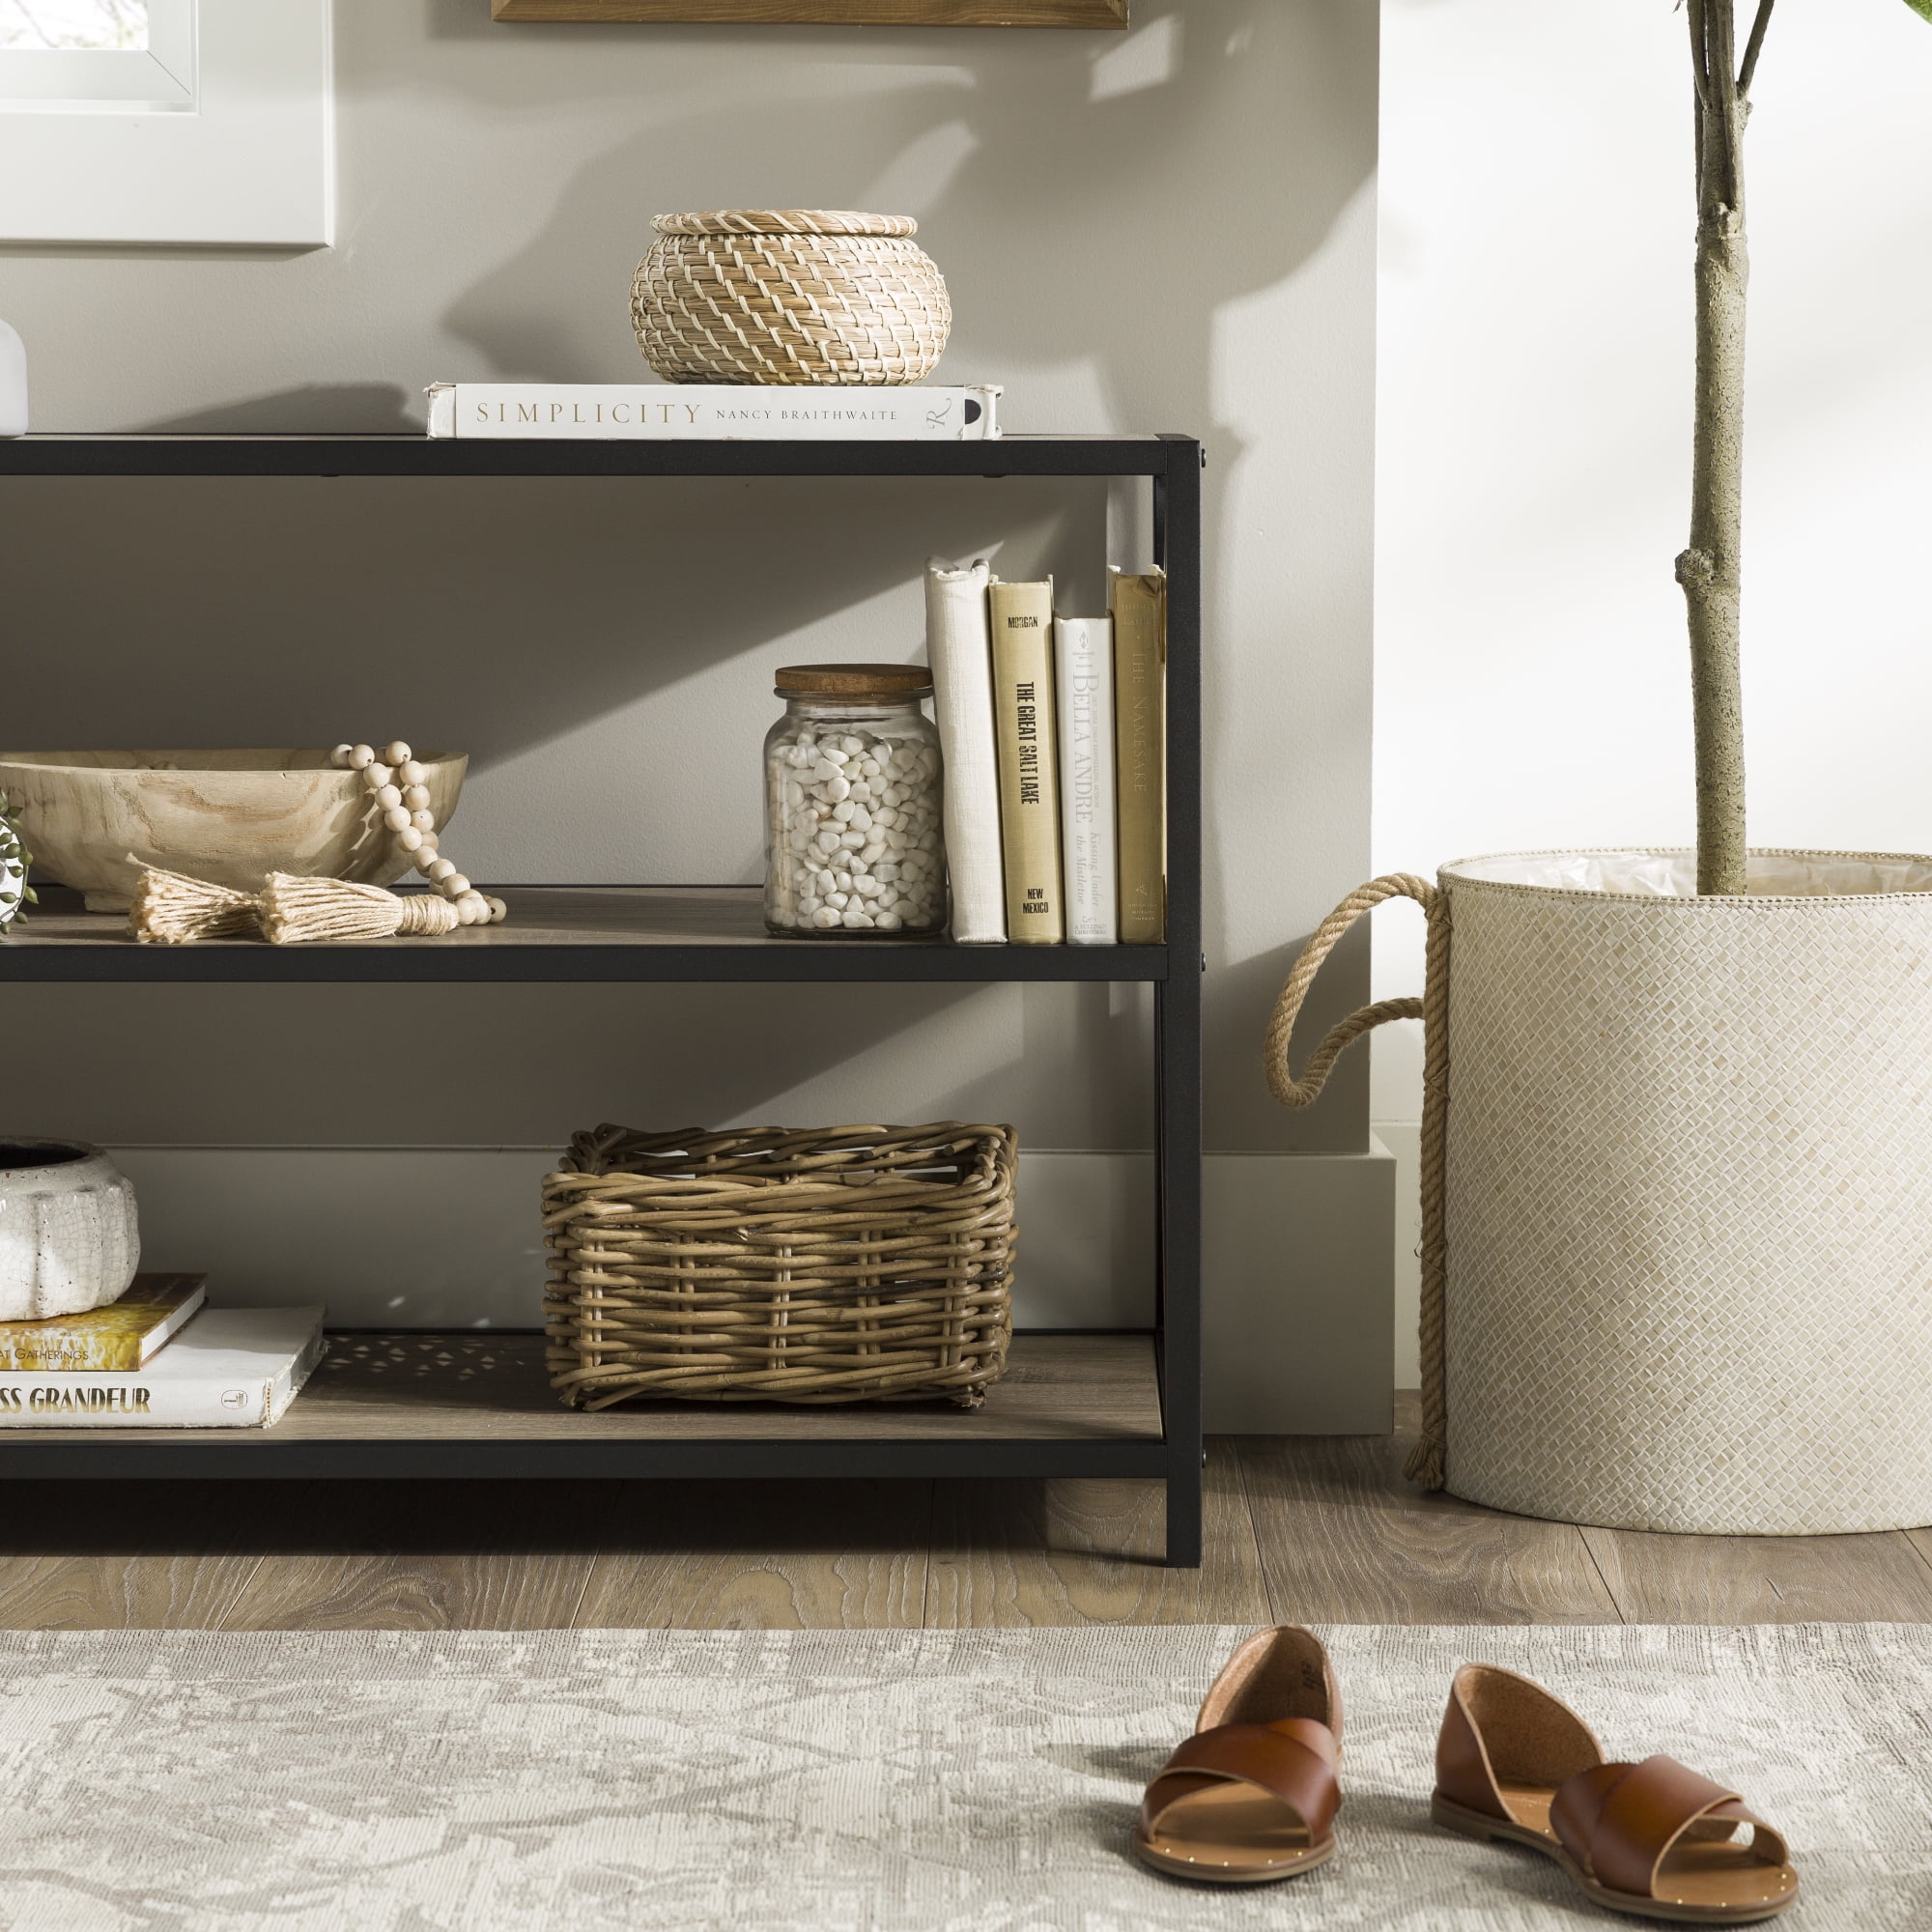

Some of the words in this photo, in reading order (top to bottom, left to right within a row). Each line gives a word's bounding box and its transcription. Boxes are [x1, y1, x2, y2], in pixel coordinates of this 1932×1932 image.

[476, 403, 703, 424] SIMPLICITY
[716, 410, 772, 420] NANCY
[781, 410, 897, 421] BRAITHWAITE
[1008, 616, 1038, 629] MORGAN
[1132, 652, 1147, 684] THE
[1016, 681, 1036, 702] THE
[1072, 672, 1099, 743] BELLA
[1017, 705, 1037, 742] GREAT
[1019, 745, 1038, 773] SALT
[1132, 696, 1149, 795] NAMESAKE
[1020, 776, 1039, 805] LAKE
[1074, 752, 1094, 824] ANDRE
[1088, 832, 1101, 871] Kissing
[1027, 888, 1043, 900] NEW
[1091, 874, 1103, 908] Under
[1022, 901, 1049, 914] MEXICO
[14, 1348, 89, 1360] GATHERINGS
[29, 1387, 151, 1413] GRANDEUR
